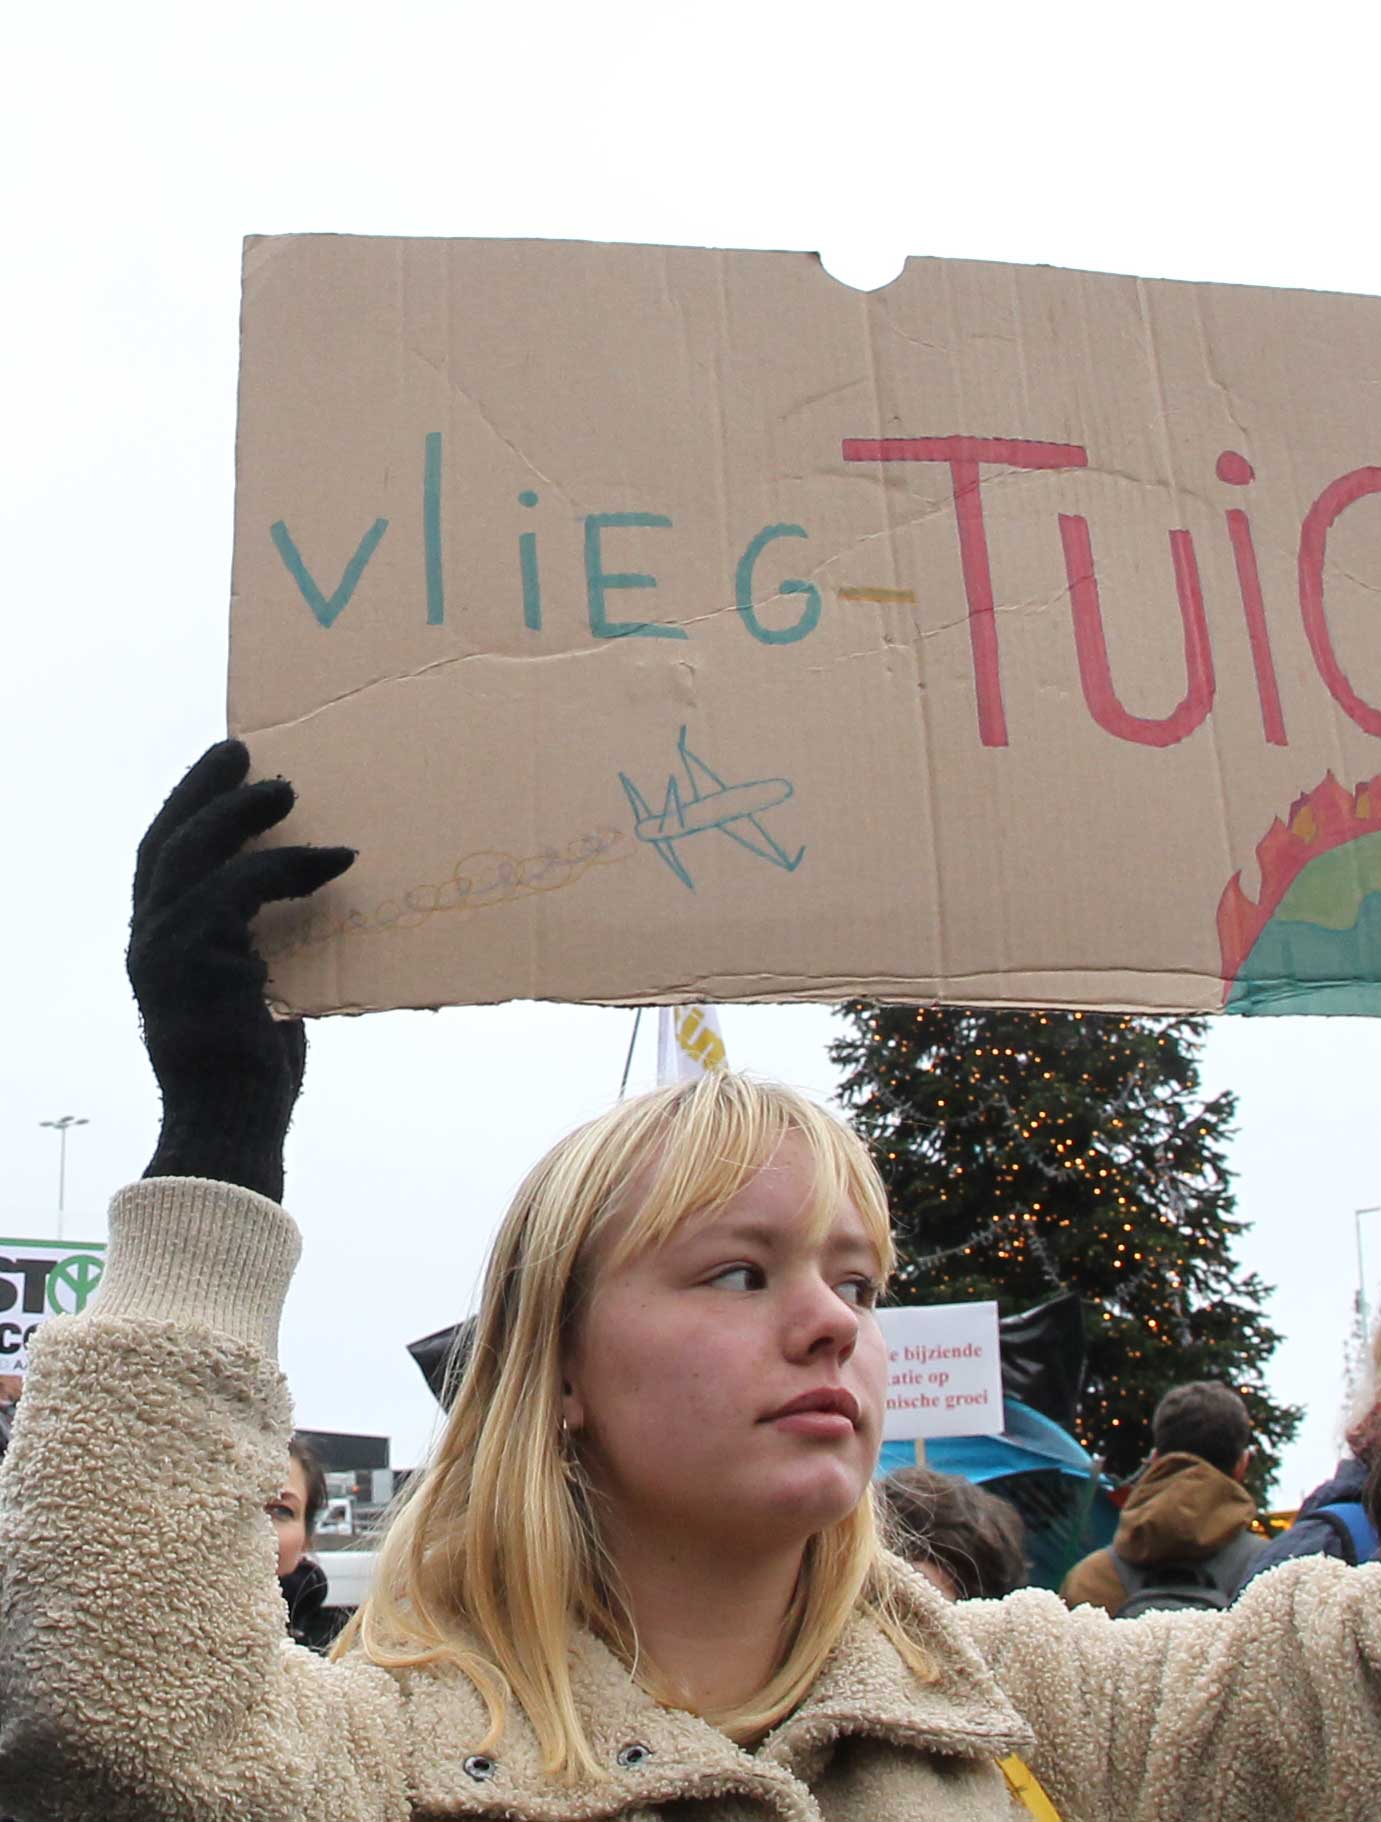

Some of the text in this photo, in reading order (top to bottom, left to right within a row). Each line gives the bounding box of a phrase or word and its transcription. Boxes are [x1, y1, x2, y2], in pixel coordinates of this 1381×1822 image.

[904, 1343, 982, 1364] bijziende
[888, 1370, 949, 1387] atie op
[945, 1389, 988, 1408] groei
